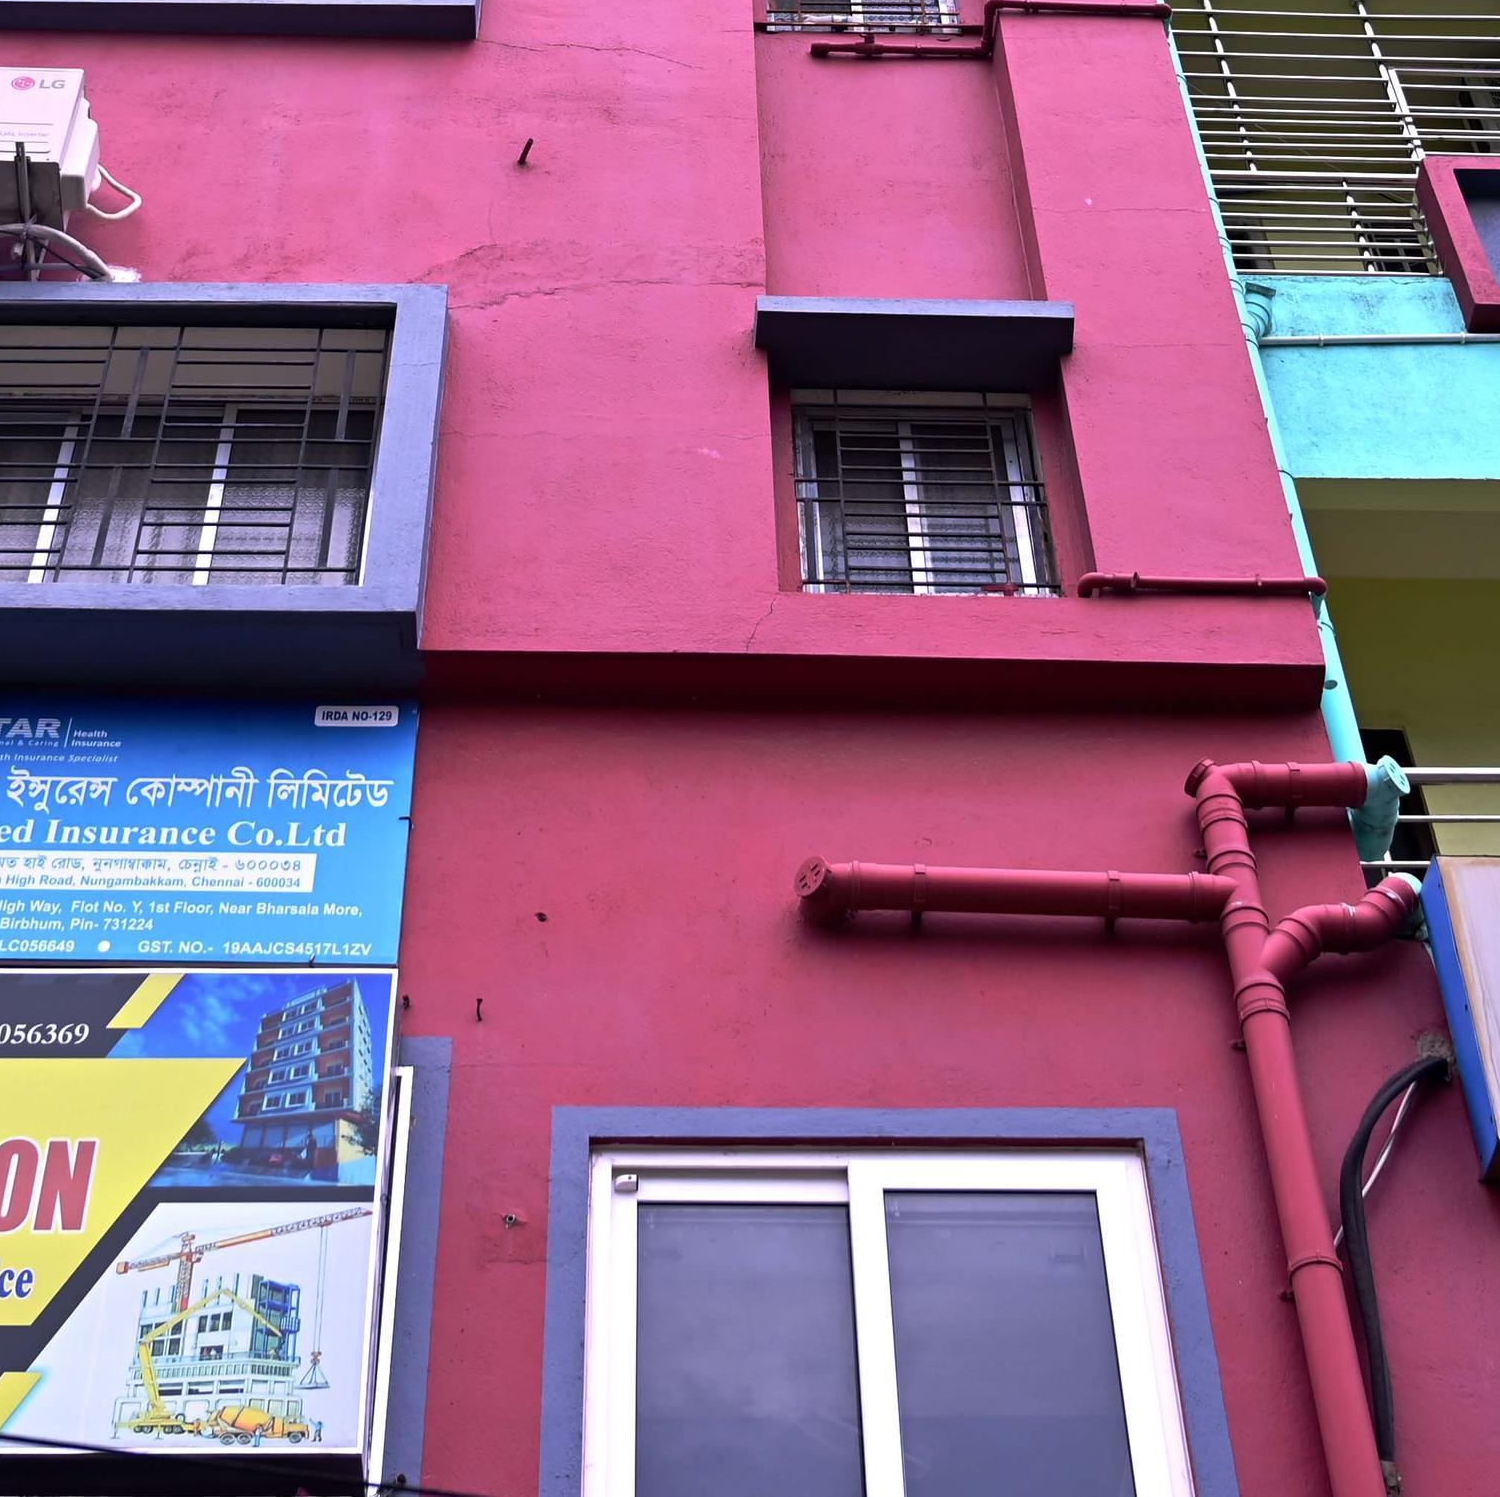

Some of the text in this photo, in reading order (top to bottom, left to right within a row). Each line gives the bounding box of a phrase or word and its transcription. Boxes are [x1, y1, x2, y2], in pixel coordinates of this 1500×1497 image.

[39, 79, 66, 89] LG
[321, 710, 393, 723] IRDA NO-129
[73, 729, 108, 739] Health
[71, 739, 122, 748] Insurance
[14, 753, 65, 762] Insurance
[125, 766, 259, 809] কোম্পানী
[267, 769, 394, 810] লিমিটেড
[44, 819, 216, 846] Insurance
[226, 820, 347, 849] Co.Ltd
[5, 874, 35, 887] High
[40, 875, 76, 888] Road,
[80, 876, 187, 890] Nungambakkam,
[192, 876, 244, 888] Chennai
[256, 877, 301, 889] 600034
[30, 900, 62, 915] Way,
[103, 901, 127, 913] No.
[132, 901, 144, 915] Y,
[148, 902, 170, 914] 1st
[174, 902, 214, 916] Floor,
[218, 902, 252, 915] Near
[256, 903, 320, 916] Bharsala
[323, 904, 363, 918] More,
[0, 917, 65, 932] Birbhum,
[103, 918, 154, 931] 731224
[138, 940, 173, 954] GST.
